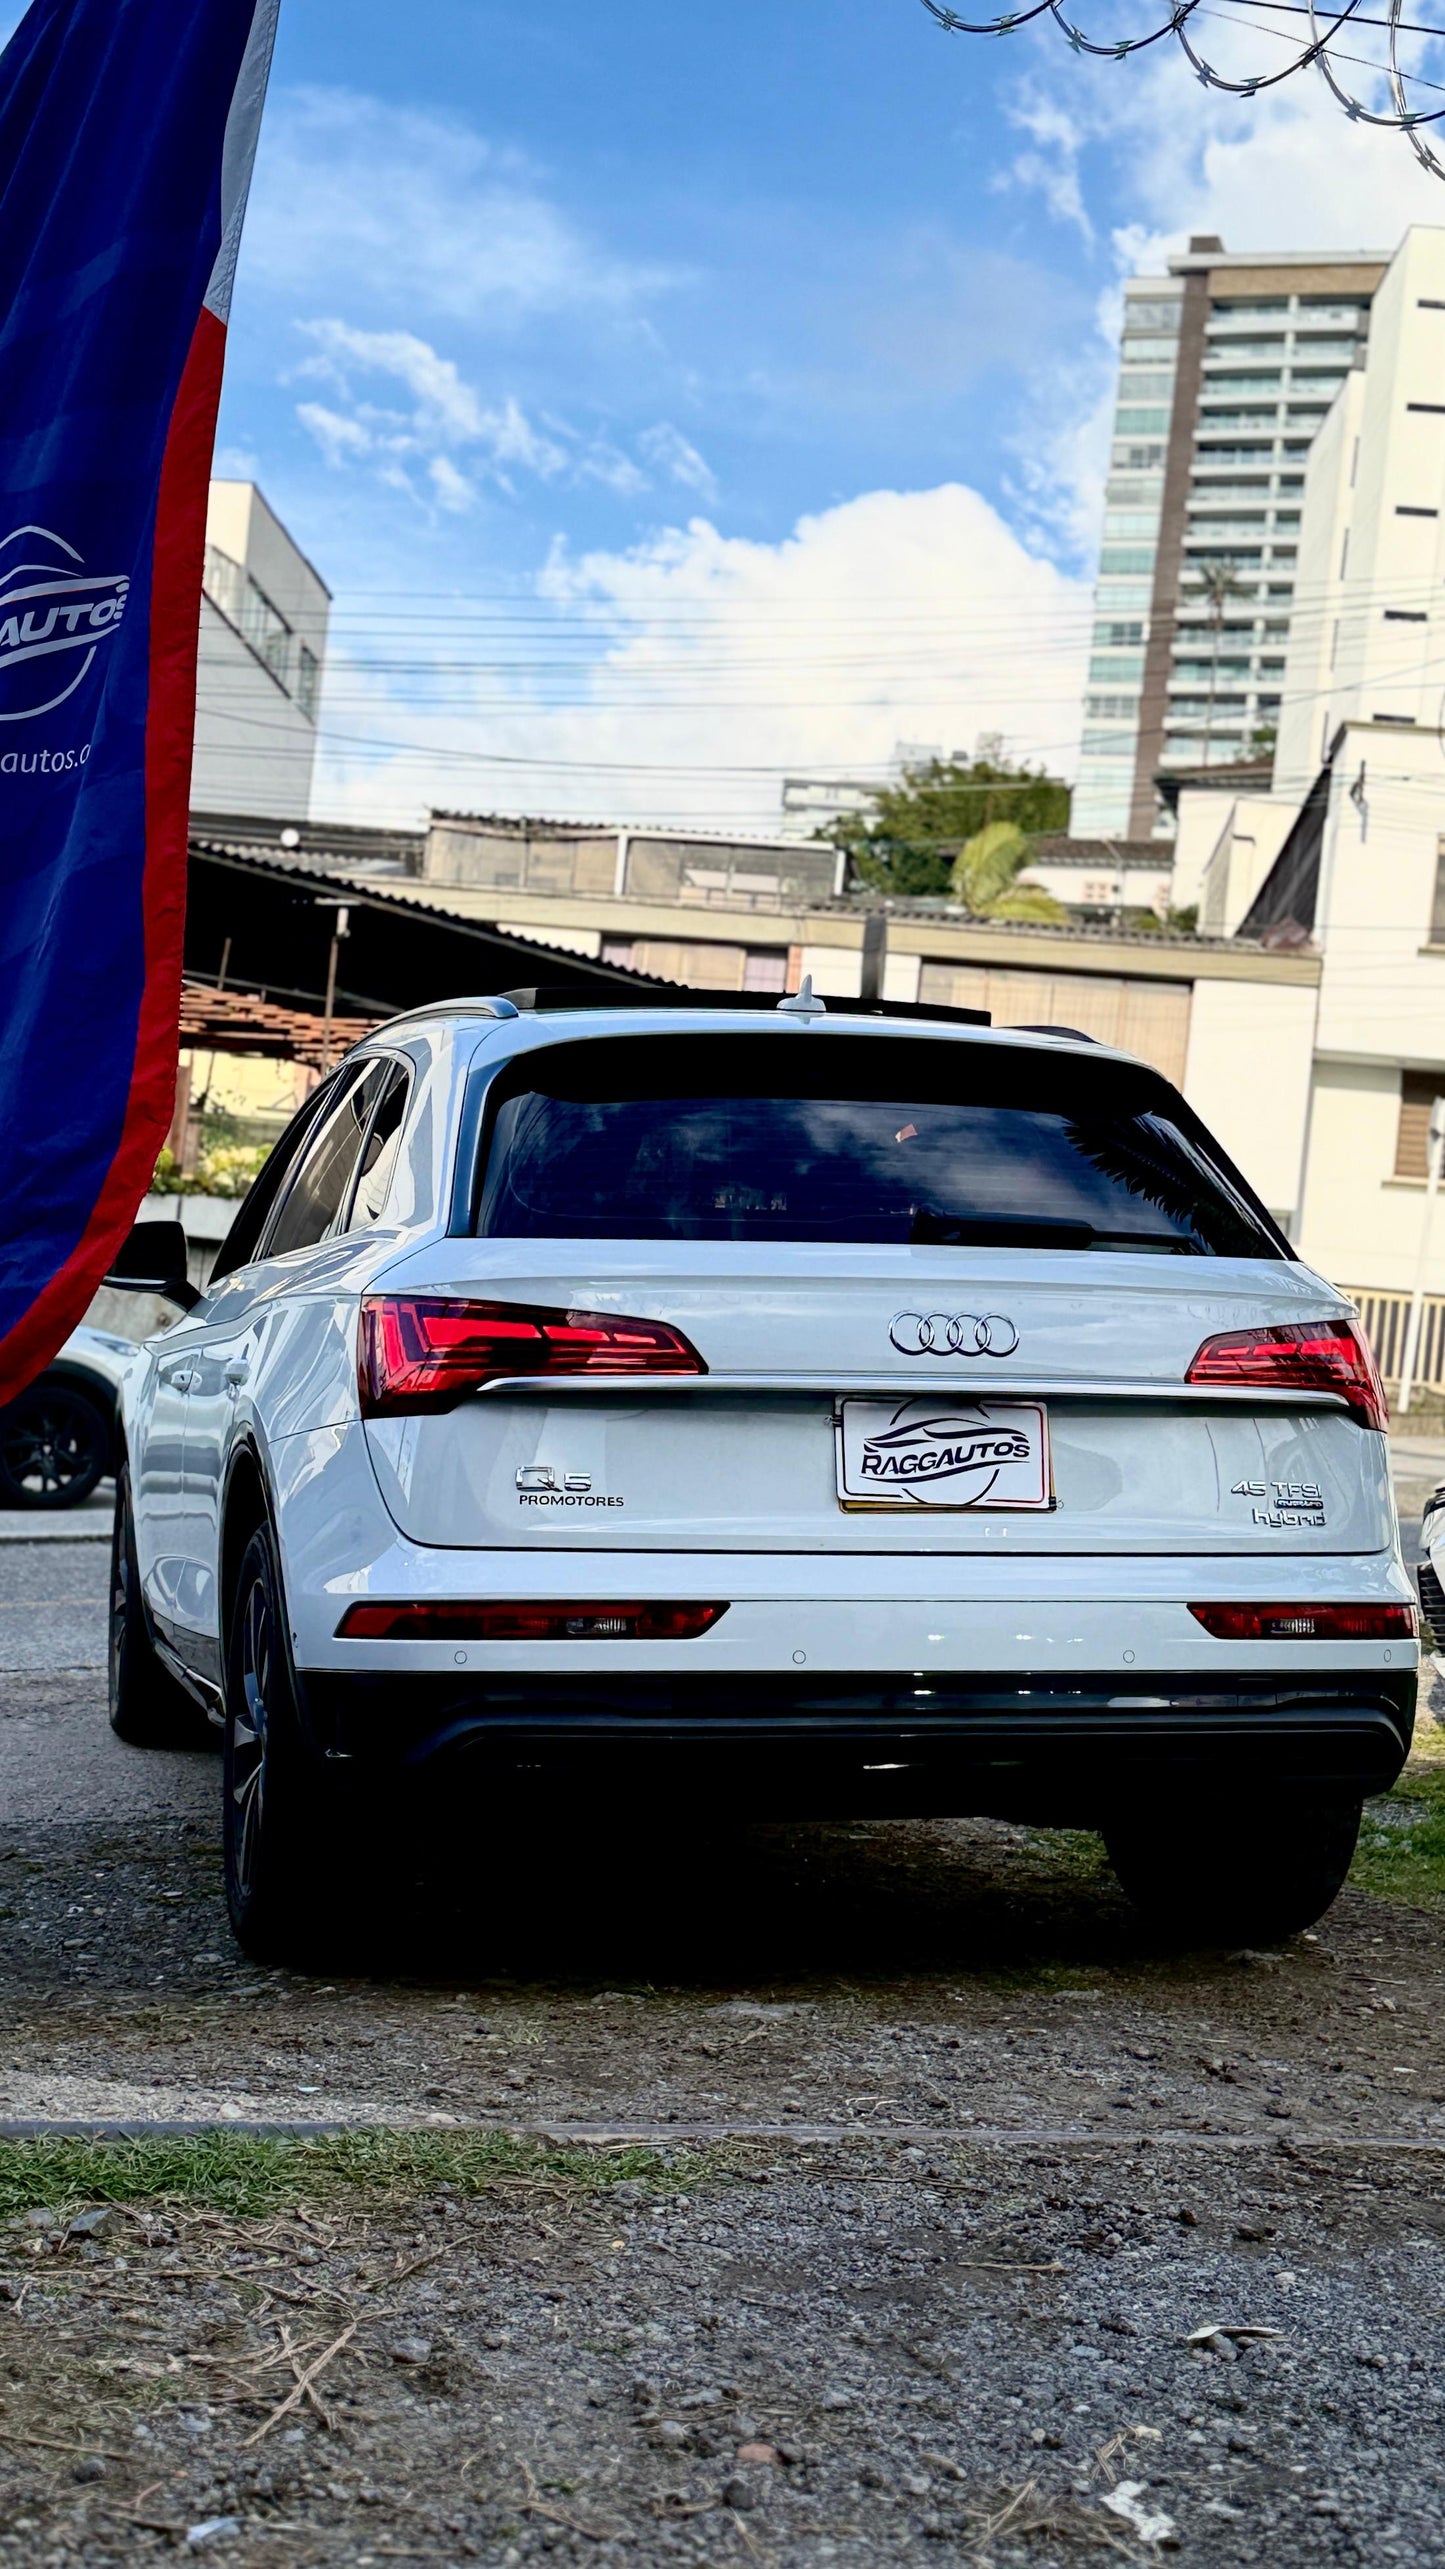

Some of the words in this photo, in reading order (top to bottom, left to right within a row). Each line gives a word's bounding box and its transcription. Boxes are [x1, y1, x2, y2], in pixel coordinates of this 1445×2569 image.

[861, 1442, 1030, 1475] RAGGAUTOS
[516, 1466, 592, 1492] Q5
[1231, 1480, 1266, 1496] 45
[1271, 1481, 1322, 1498] TFSI
[519, 1495, 624, 1507] PROMOTORES
[1252, 1508, 1327, 1527] hybrid
